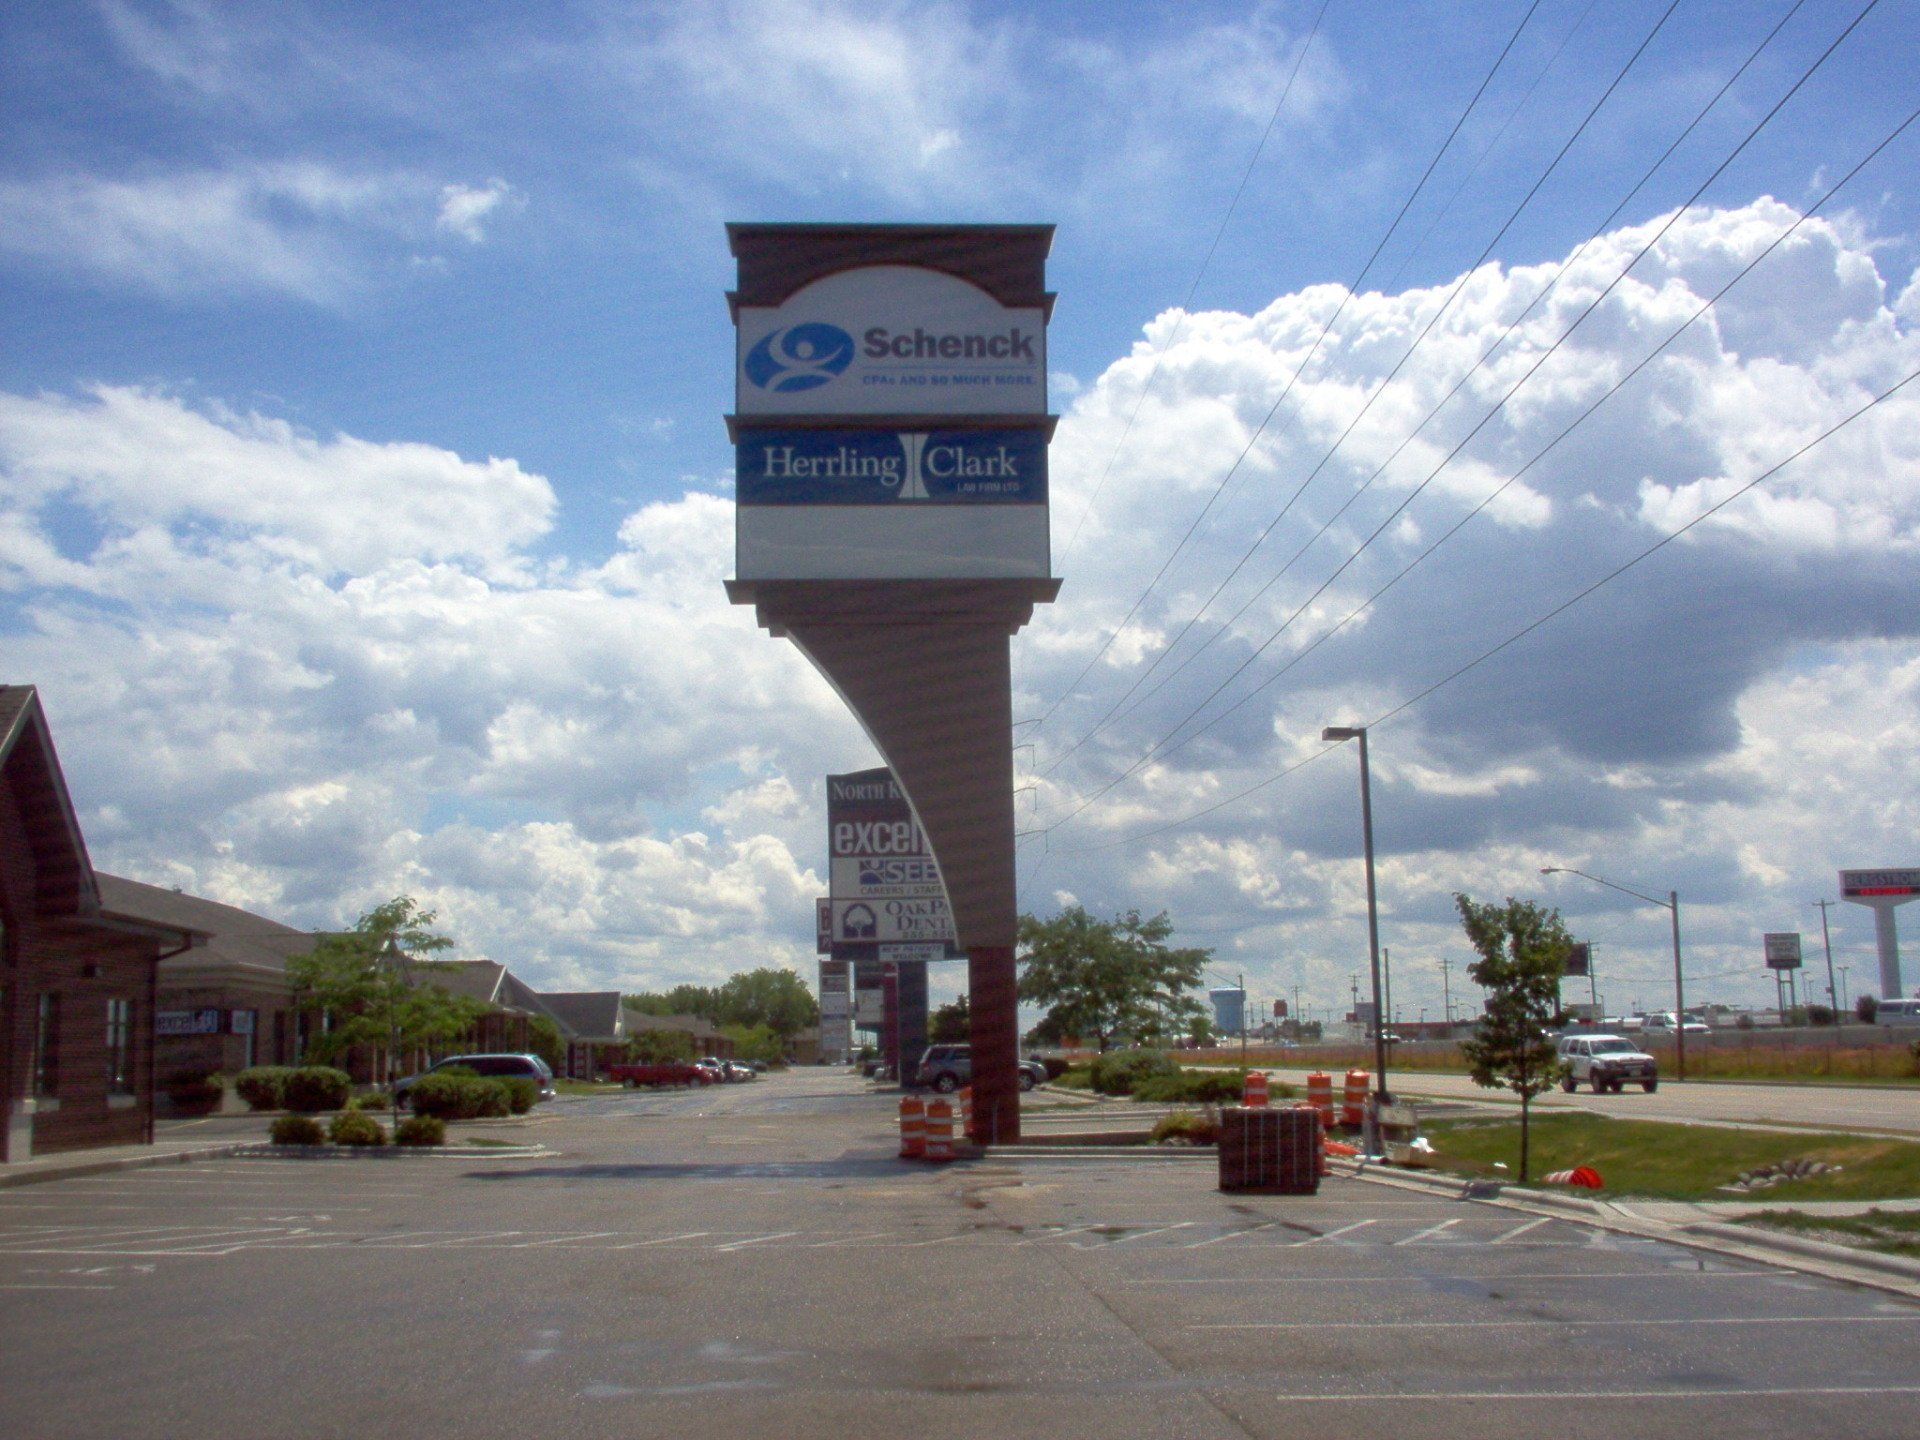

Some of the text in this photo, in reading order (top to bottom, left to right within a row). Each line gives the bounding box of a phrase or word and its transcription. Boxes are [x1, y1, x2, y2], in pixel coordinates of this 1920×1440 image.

[863, 326, 1034, 359] Schenck
[900, 374, 927, 386] AND
[930, 374, 949, 386] SO
[953, 374, 991, 386] MUCH
[763, 446, 1019, 486] Herrling Clark
[957, 482, 976, 493] LAW
[978, 482, 1000, 493] FIRM
[832, 781, 885, 801] NORTH
[860, 886, 904, 895] CAREERS
[884, 899, 927, 916] OAK
[896, 915, 949, 931] DENT
